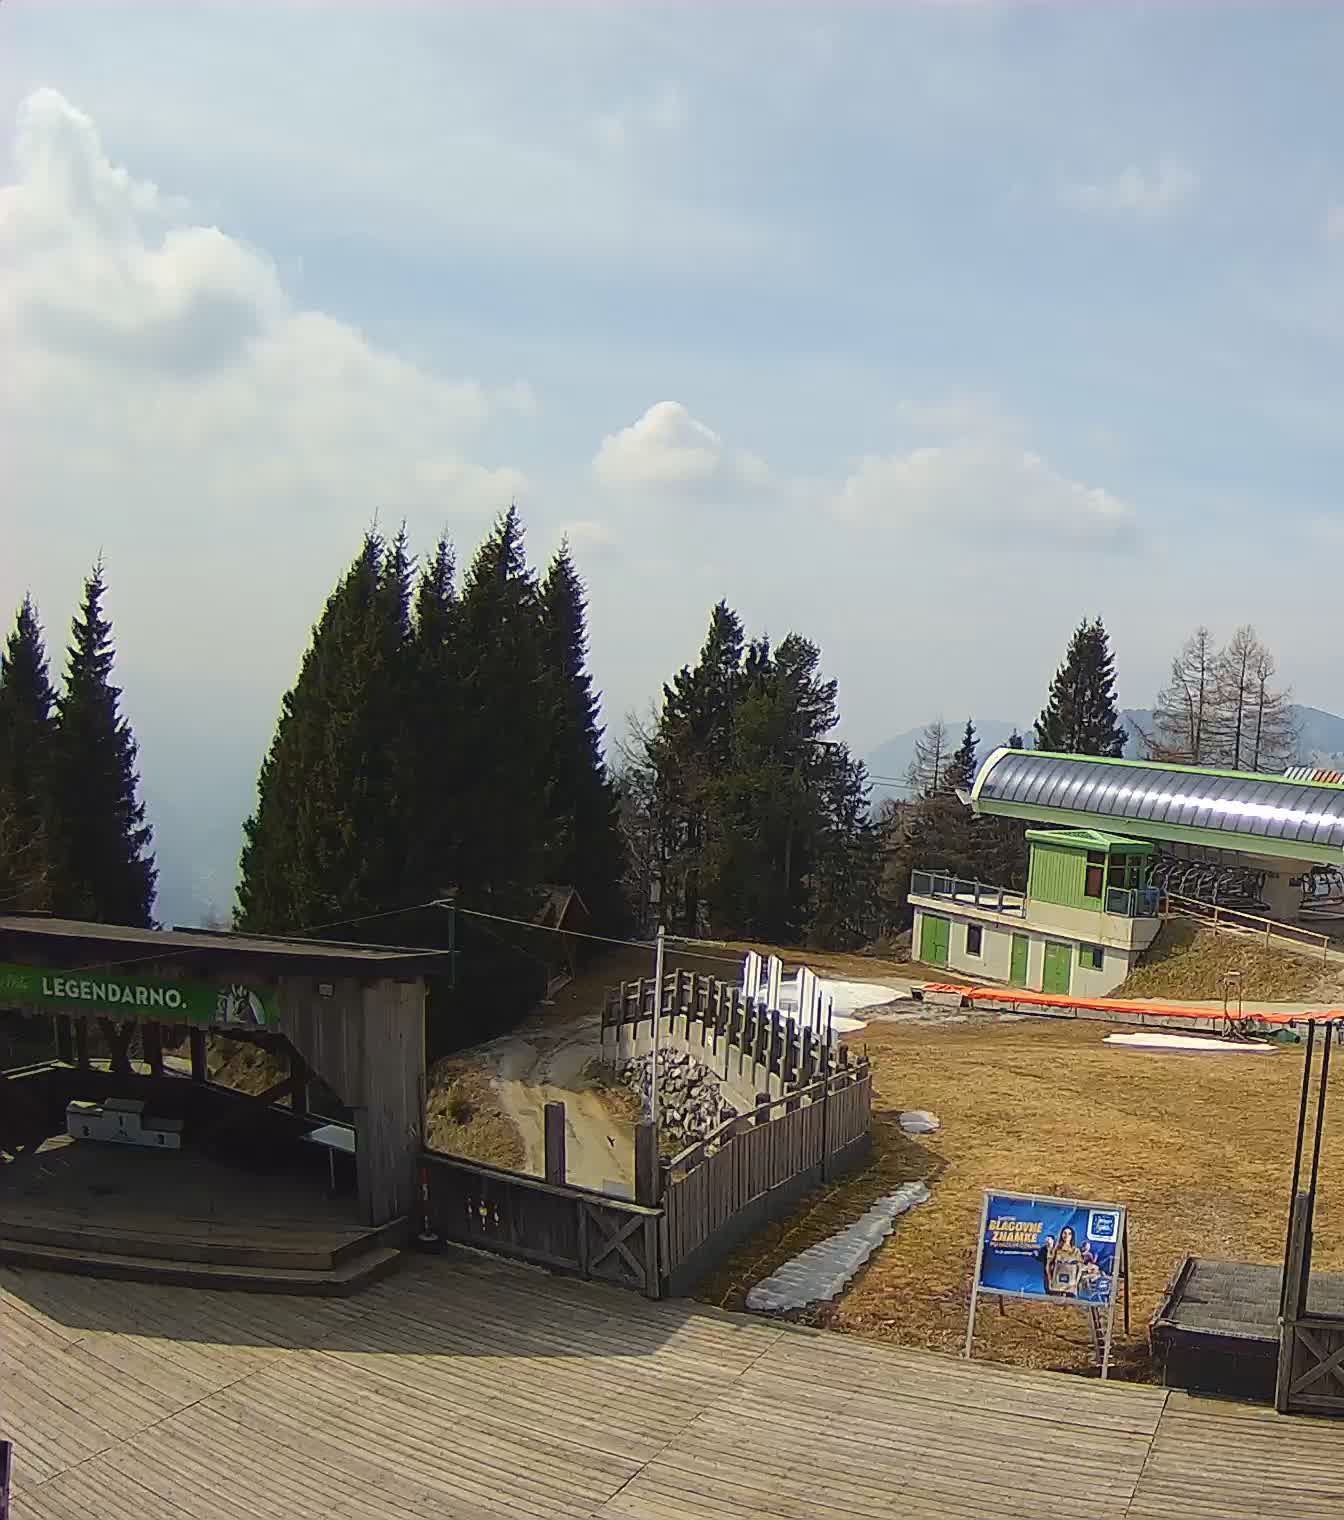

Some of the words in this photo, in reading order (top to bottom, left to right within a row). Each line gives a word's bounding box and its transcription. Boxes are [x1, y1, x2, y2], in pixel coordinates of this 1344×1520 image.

[42, 976, 188, 1009] LEGENDARNO.
[988, 1219, 1043, 1233] BLAGOVNE
[992, 1231, 1037, 1243] ZNAMKE
